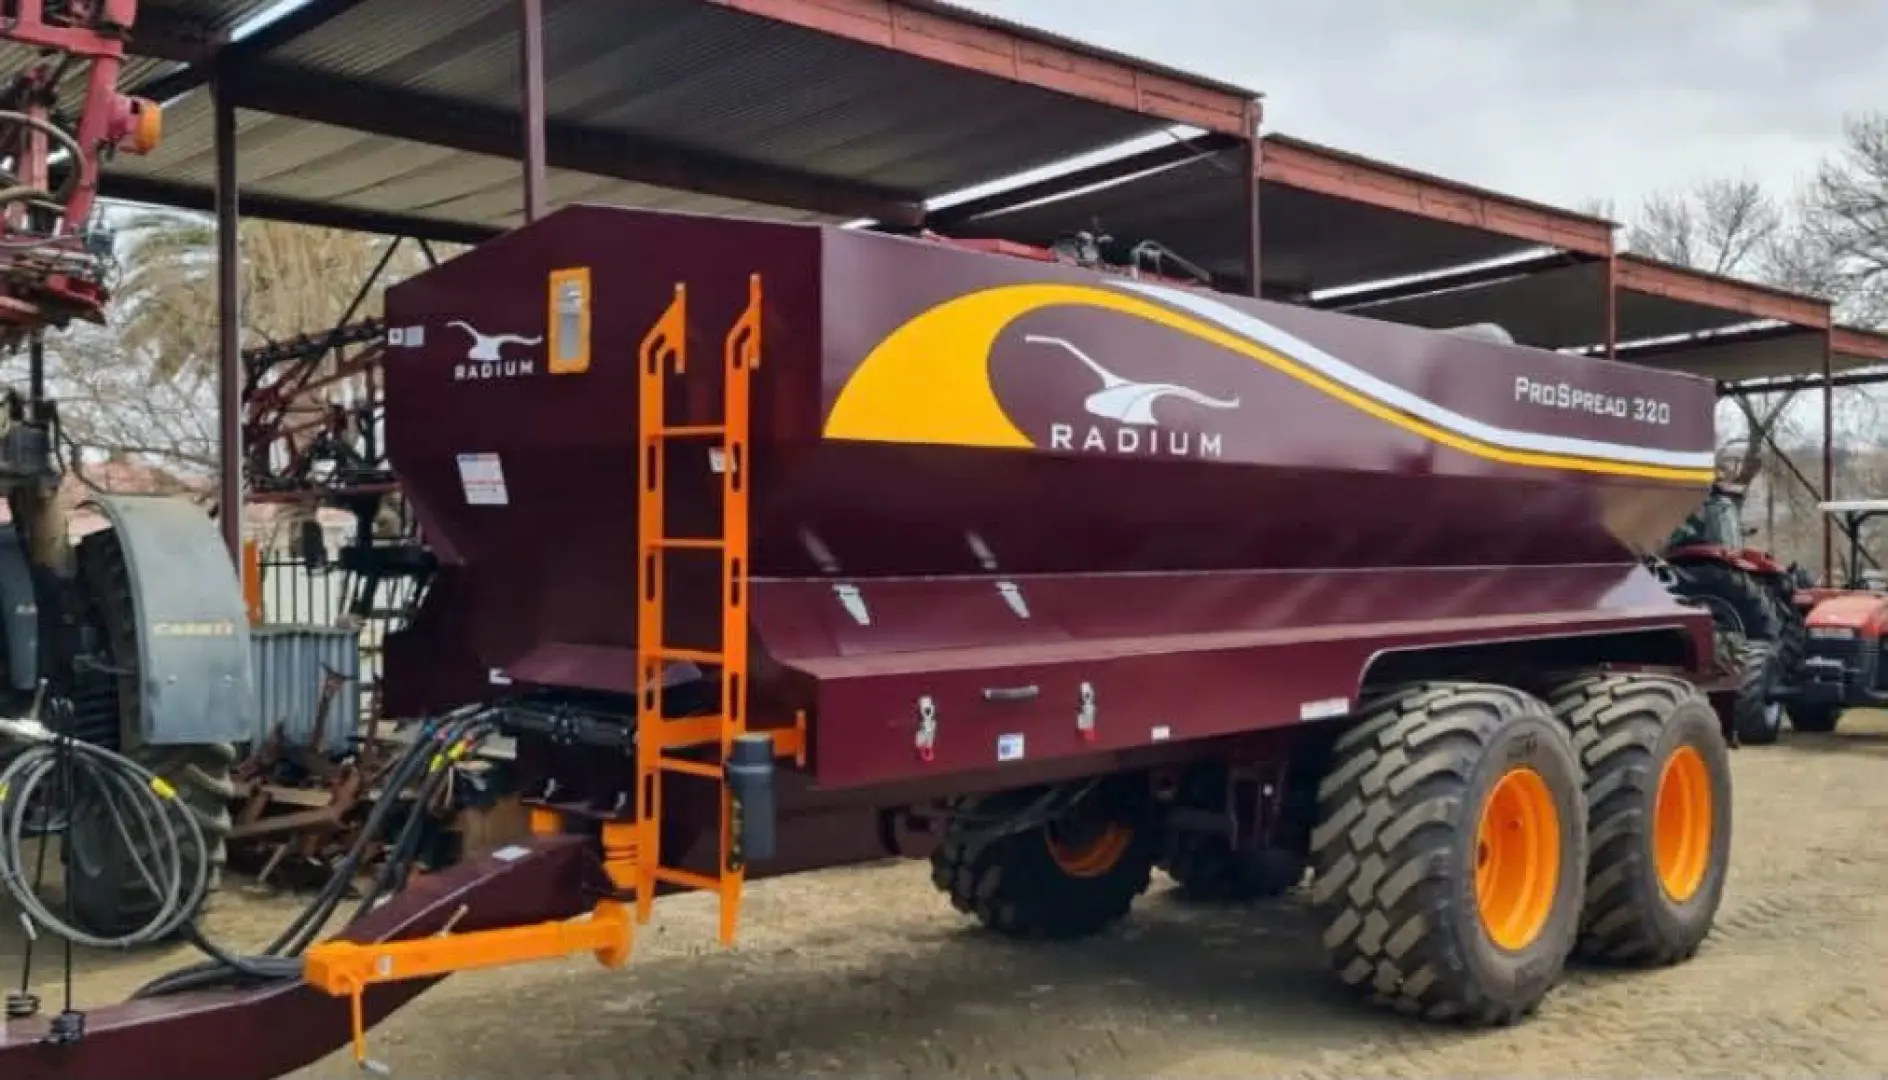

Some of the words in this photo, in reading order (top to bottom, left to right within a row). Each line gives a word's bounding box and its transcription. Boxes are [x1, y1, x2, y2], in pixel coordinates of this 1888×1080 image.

[454, 360, 534, 379] RADIUM
[1633, 397, 1671, 425] 320
[1051, 423, 1222, 457] RADIUM
